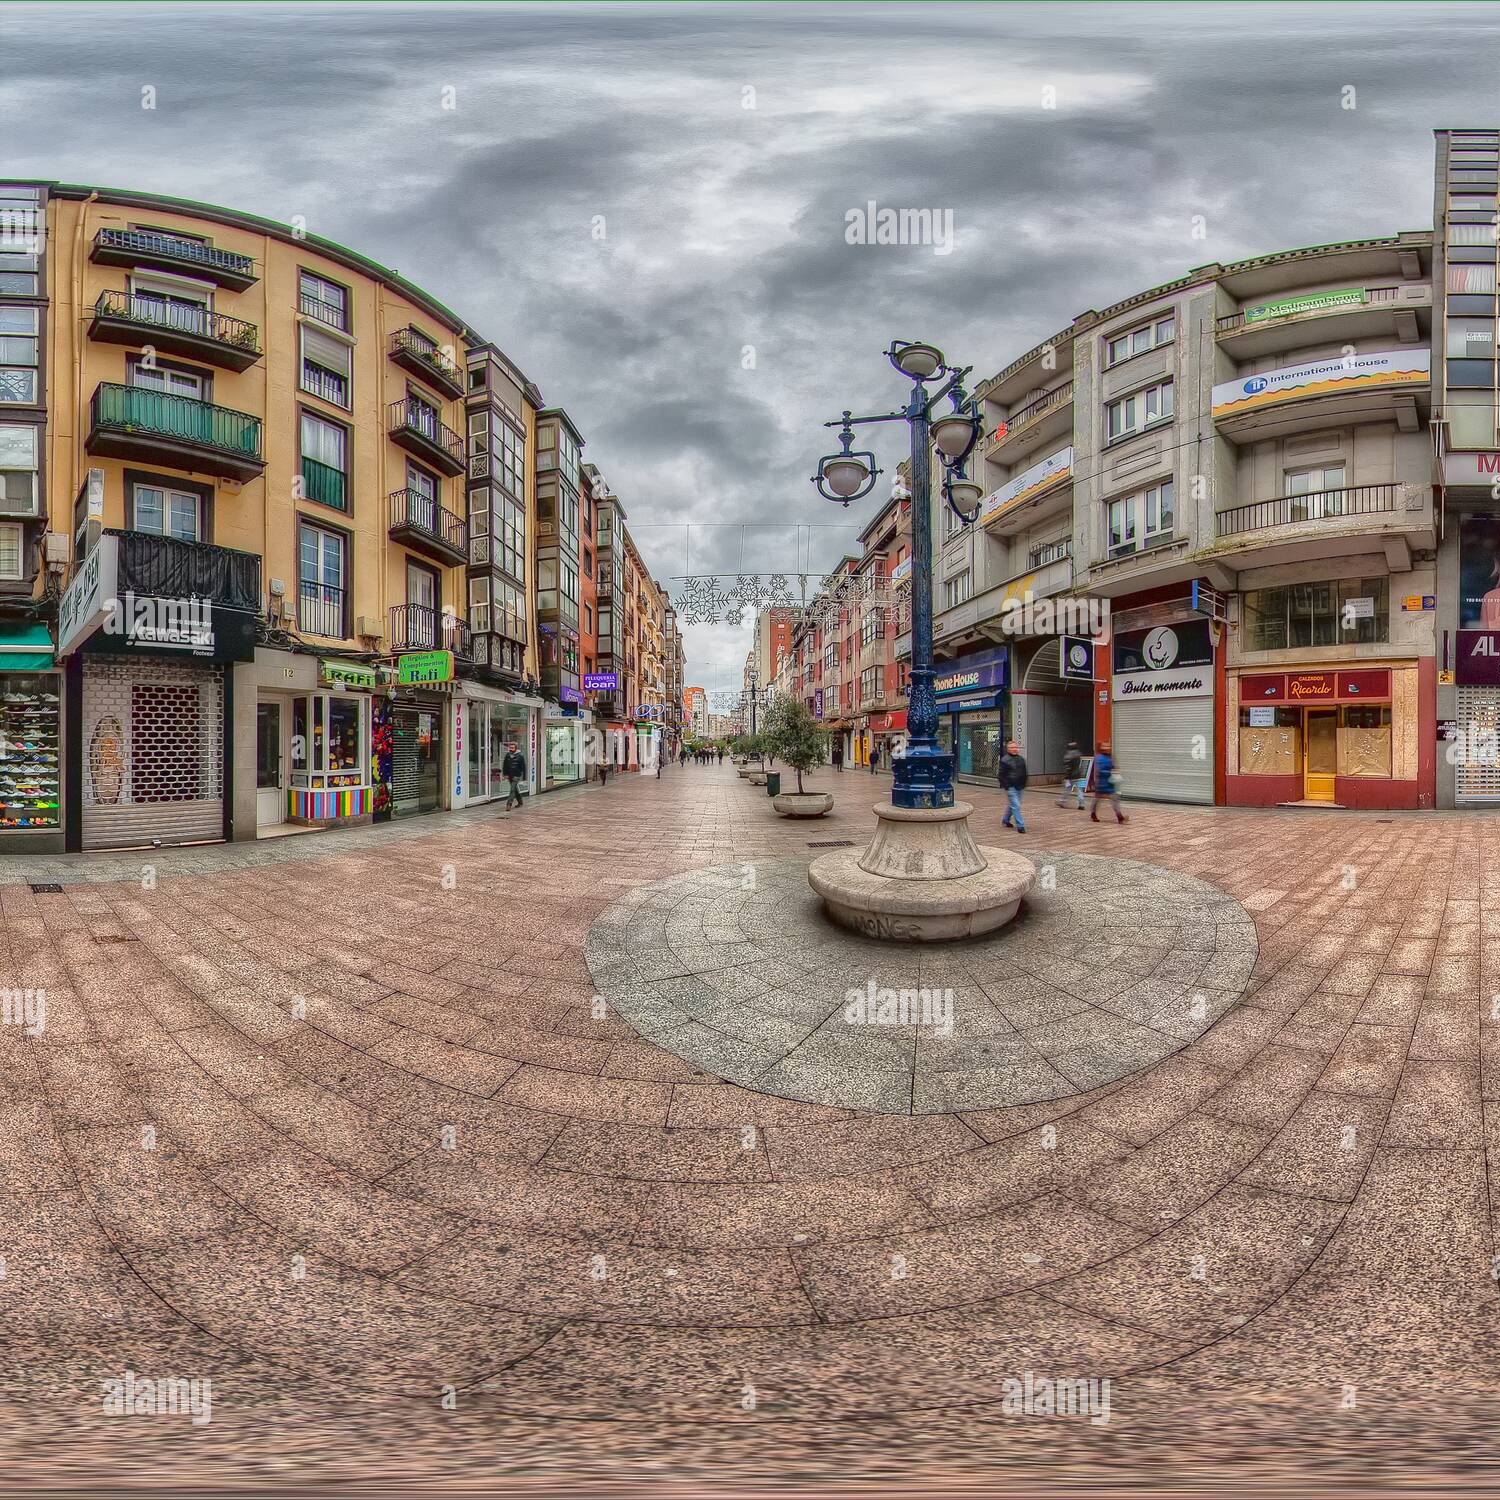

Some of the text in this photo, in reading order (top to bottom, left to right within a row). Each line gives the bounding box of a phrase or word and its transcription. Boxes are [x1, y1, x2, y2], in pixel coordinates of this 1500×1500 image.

[1270, 357, 1389, 384] International House
[284, 668, 294, 678] 12
[410, 668, 438, 681] Rafi
[585, 681, 616, 689] Joan
[1122, 678, 1203, 694] Dulce momento
[1291, 681, 1332, 699] Ricardo
